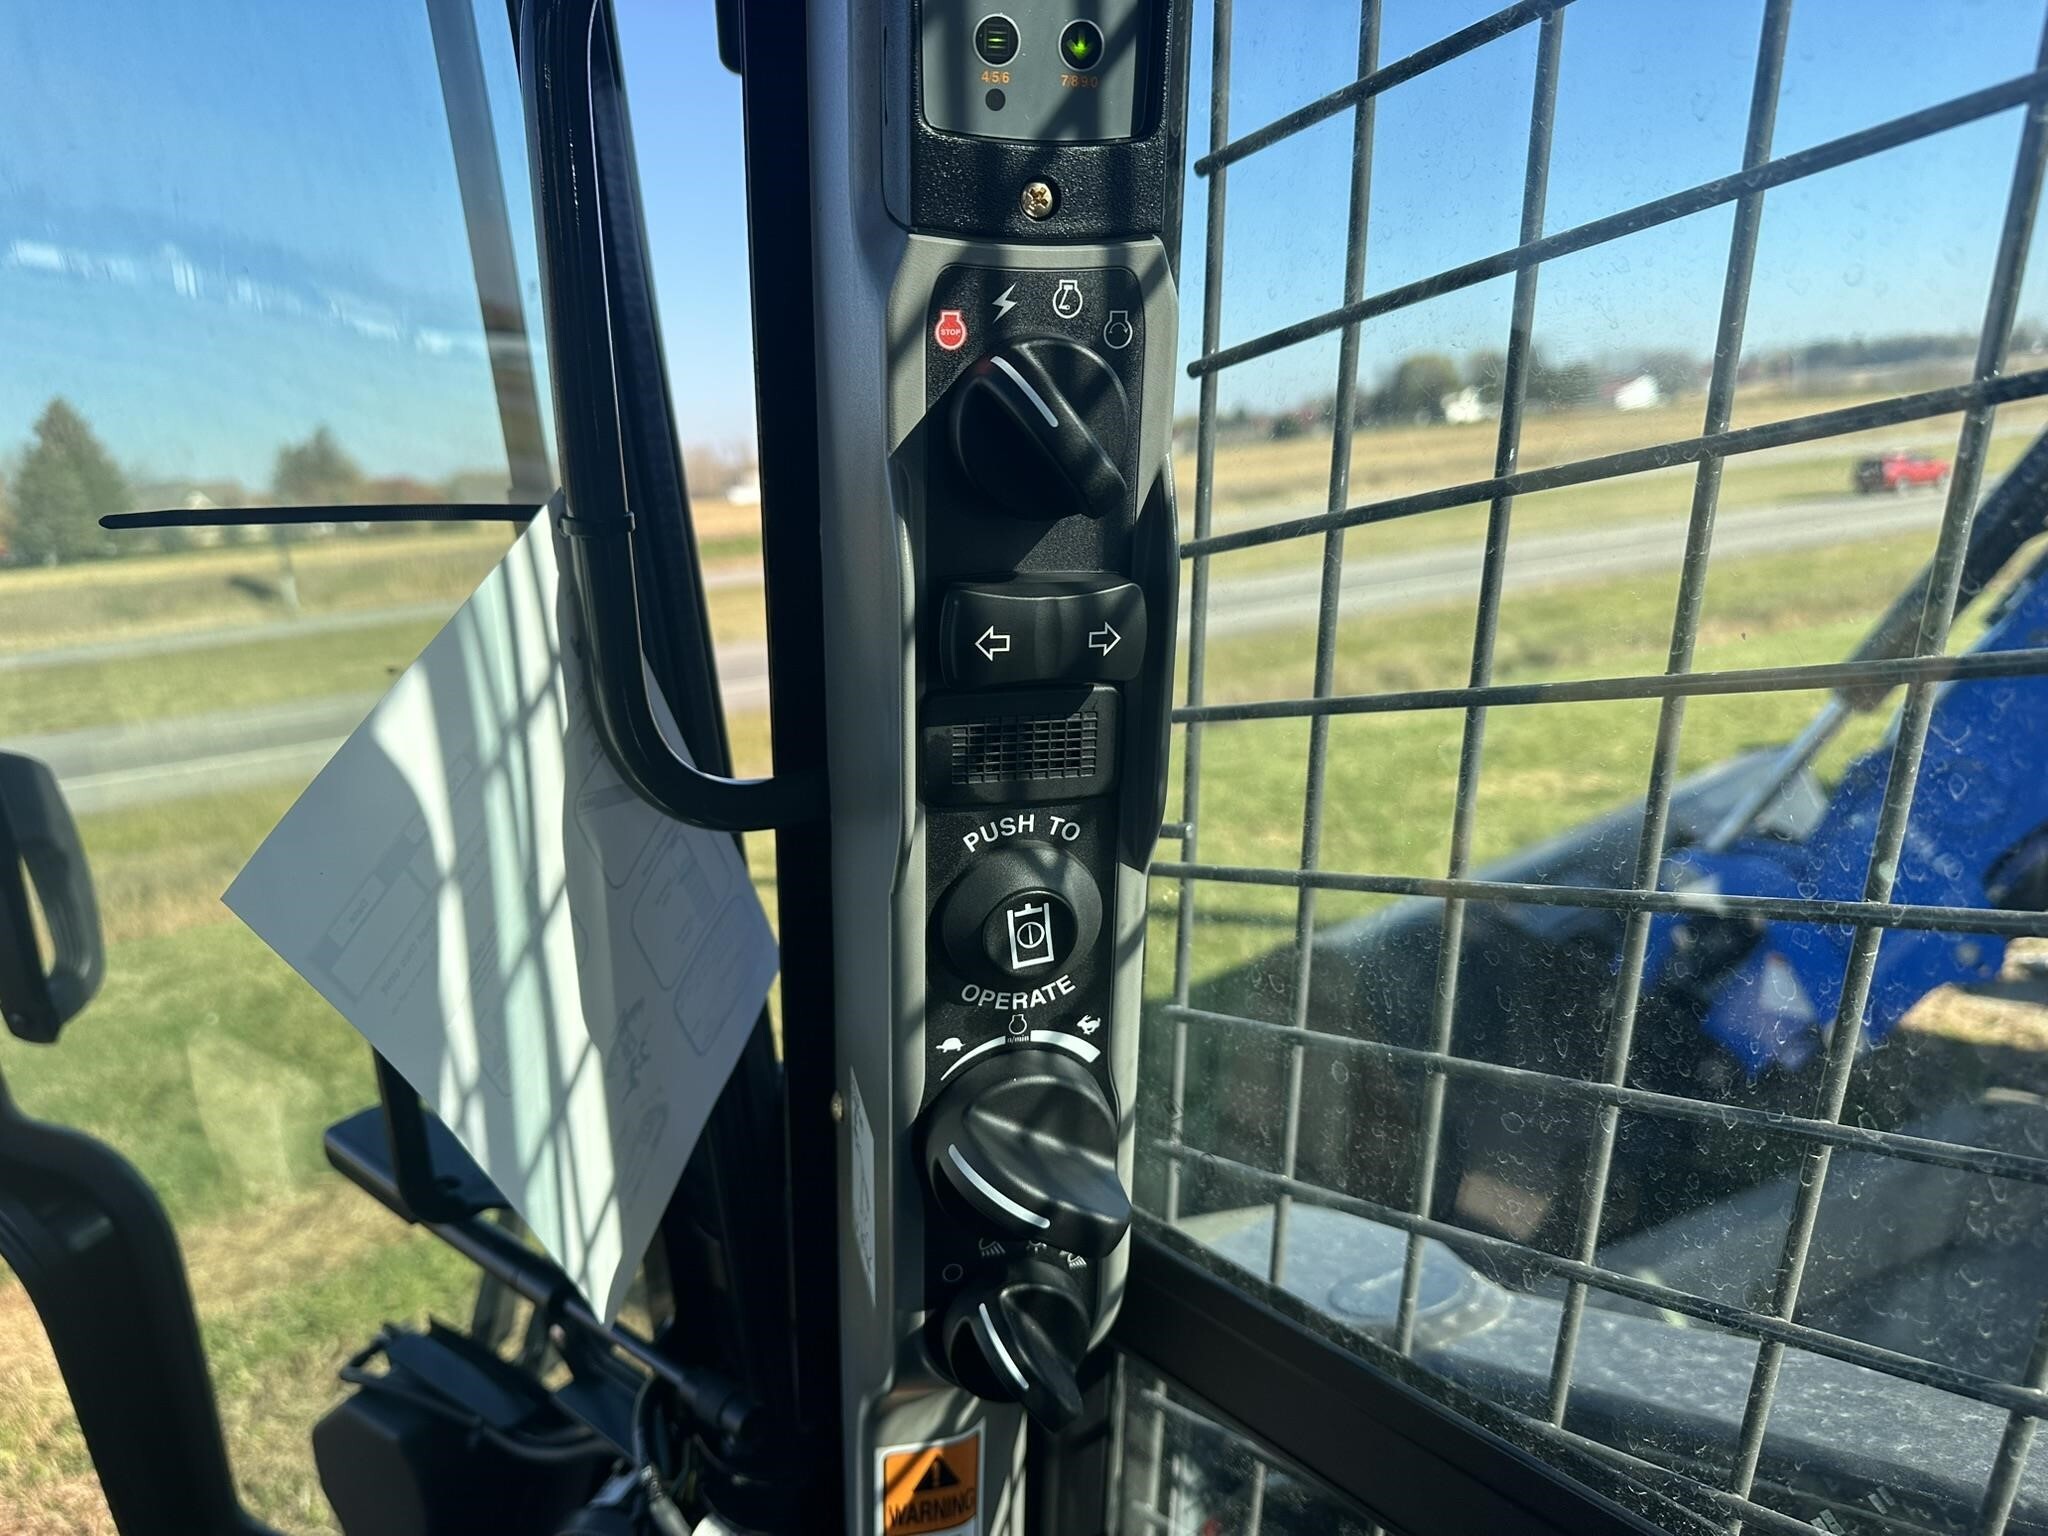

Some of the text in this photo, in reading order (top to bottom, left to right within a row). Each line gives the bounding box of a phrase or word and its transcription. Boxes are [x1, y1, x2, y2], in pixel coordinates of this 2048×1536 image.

[940, 328, 961, 336] STOP
[962, 814, 1081, 853] PUSH TO
[961, 974, 1076, 1010] OPERATE
[888, 1488, 976, 1527] WARNING
